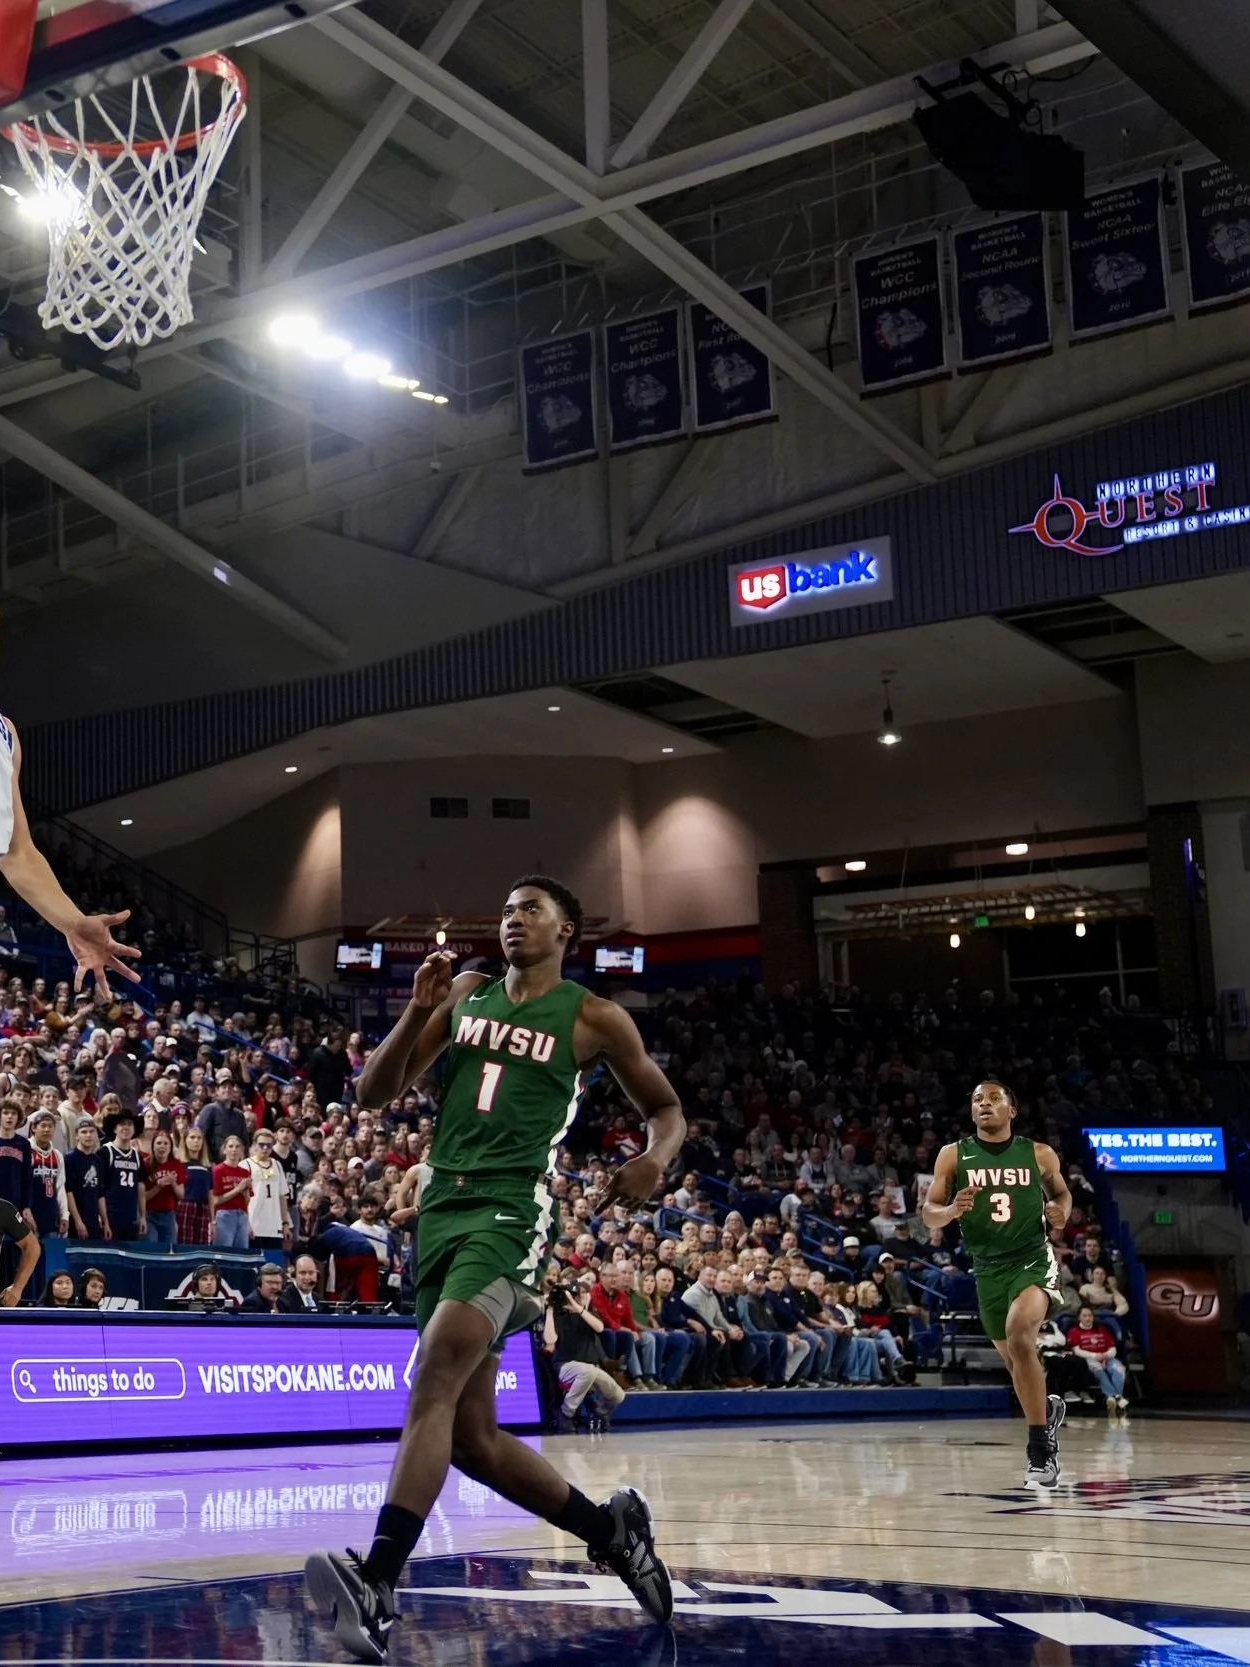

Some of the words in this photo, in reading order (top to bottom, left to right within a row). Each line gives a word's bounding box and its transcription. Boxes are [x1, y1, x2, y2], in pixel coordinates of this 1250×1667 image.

[1097, 213, 1132, 231] NCAA
[981, 246, 1018, 265] NCAA
[1071, 231, 1111, 251] Sweet
[861, 280, 938, 310] Champions
[880, 270, 916, 290] WCC
[1096, 462, 1216, 500] NORTHERN
[1008, 473, 1216, 556] QUEST
[1123, 520, 1180, 544] RESORT
[1184, 517, 1199, 531] &
[1202, 505, 1250, 528] CASIN
[741, 573, 781, 602] us
[786, 550, 875, 594] bank
[384, 941, 426, 953] BAKED
[428, 942, 474, 954] POTATO
[454, 1015, 557, 1063] MVSU
[476, 1061, 504, 1113] 1
[1088, 1133, 1163, 1148] YES.THE
[1167, 1133, 1218, 1148] BEST.
[1121, 1154, 1213, 1164] NORTHERNQUEST.COM
[120, 1171, 135, 1188] 24
[265, 1183, 272, 1199] 1
[966, 1168, 1031, 1188] MVSU
[989, 1192, 1013, 1223] 3
[1148, 1282, 1219, 1318] GU
[52, 1366, 109, 1398] things
[110, 1368, 130, 1391] to
[133, 1366, 155, 1391] do
[198, 1364, 395, 1394] VISITSPOKANE.COM
